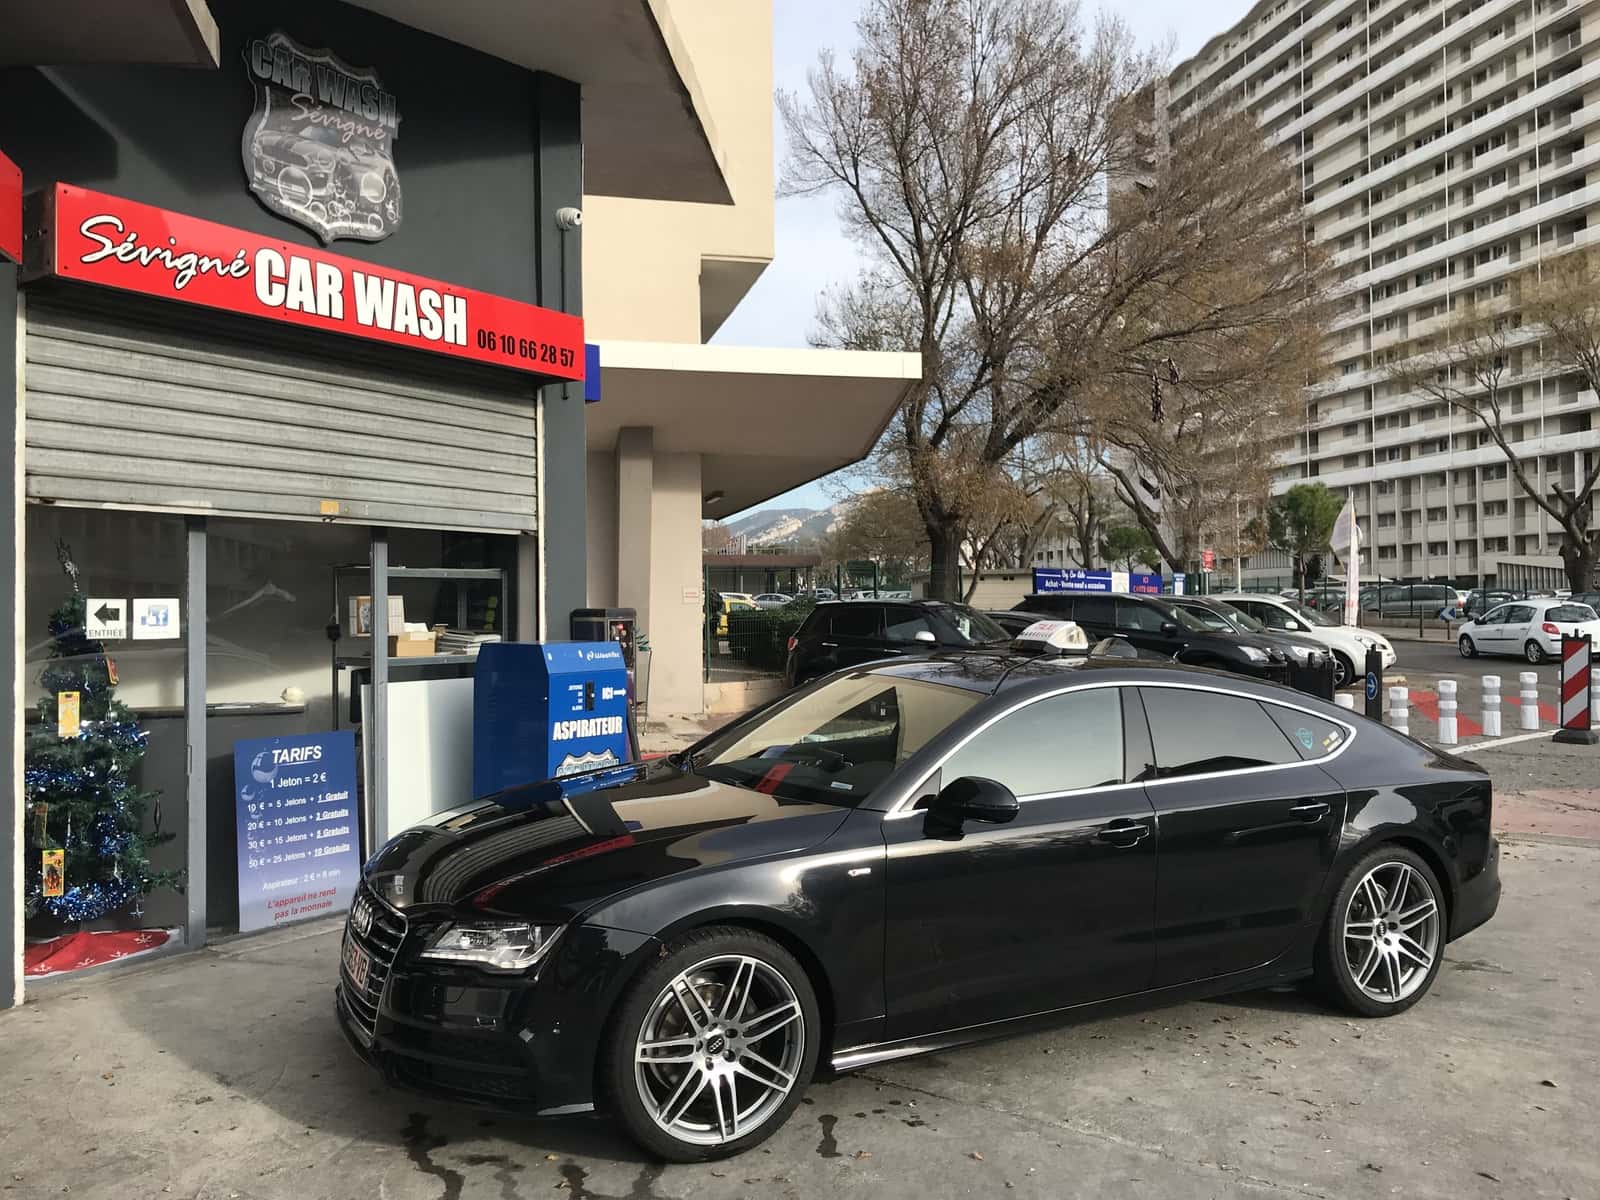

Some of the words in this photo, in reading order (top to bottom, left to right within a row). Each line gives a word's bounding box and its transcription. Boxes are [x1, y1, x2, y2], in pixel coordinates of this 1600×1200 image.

[251, 40, 313, 95] CAR
[316, 64, 397, 128] WASH
[291, 93, 386, 143] Sévigné
[80, 214, 250, 290] Sévigné
[254, 248, 344, 320] CAR
[352, 270, 468, 346] WASH
[477, 328, 496, 351] 06
[500, 334, 515, 355] 10
[519, 338, 537, 360] 66
[540, 343, 557, 364] 28
[560, 348, 575, 368] 57
[88, 627, 125, 638] ENTRÉE
[602, 687, 613, 700] ICI
[552, 716, 623, 741] ASPIRATEUR
[272, 745, 322, 763] TARIFS
[270, 778, 274, 788] 1
[277, 775, 302, 787] Jeton
[312, 773, 318, 783] 2
[320, 771, 326, 782] €
[276, 799, 281, 807] 5
[247, 821, 256, 830] 20
[274, 817, 282, 826] 10
[248, 840, 257, 849] 30
[274, 836, 283, 844] 15
[319, 886, 336, 898] rend
[274, 910, 288, 920] pas
